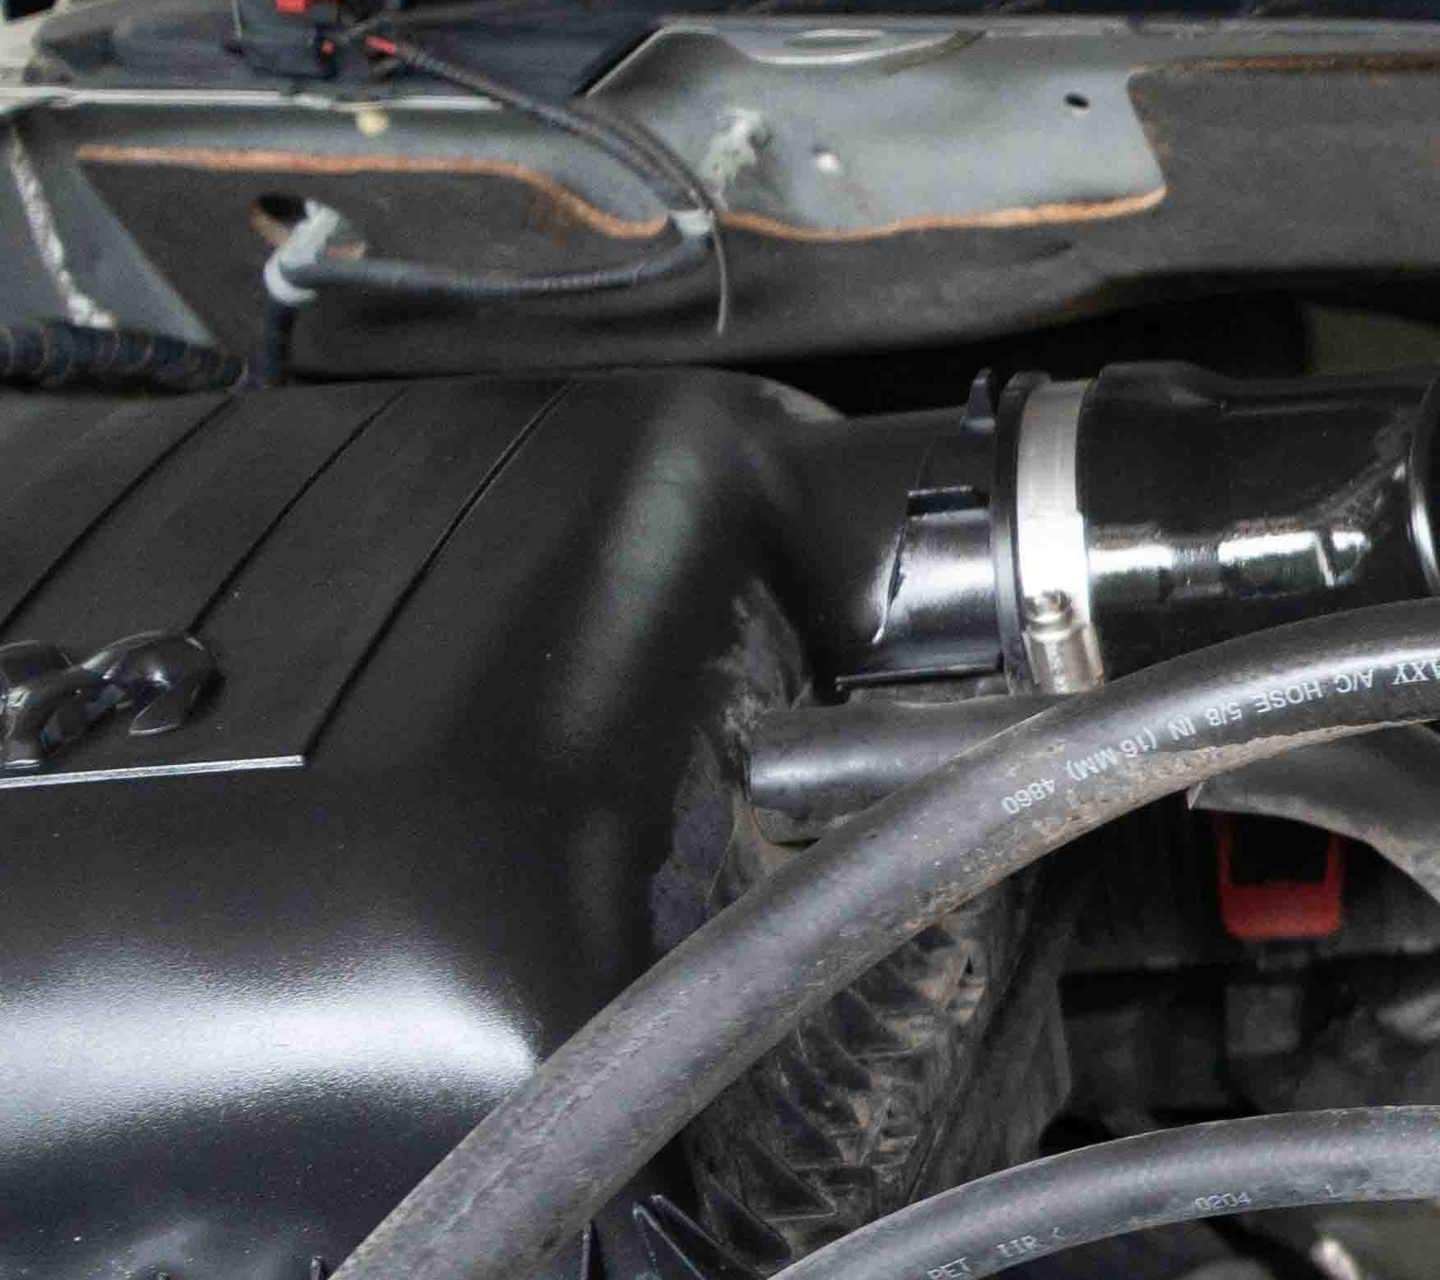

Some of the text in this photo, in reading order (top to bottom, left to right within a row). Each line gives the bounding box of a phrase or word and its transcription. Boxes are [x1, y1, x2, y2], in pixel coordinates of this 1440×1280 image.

[1254, 680, 1324, 714] HOSE
[1334, 668, 1374, 695] A/C
[1168, 714, 1198, 742] IN
[1206, 701, 1242, 727] 5/8
[1066, 746, 1119, 783] MM)
[1000, 777, 1056, 816] 4860
